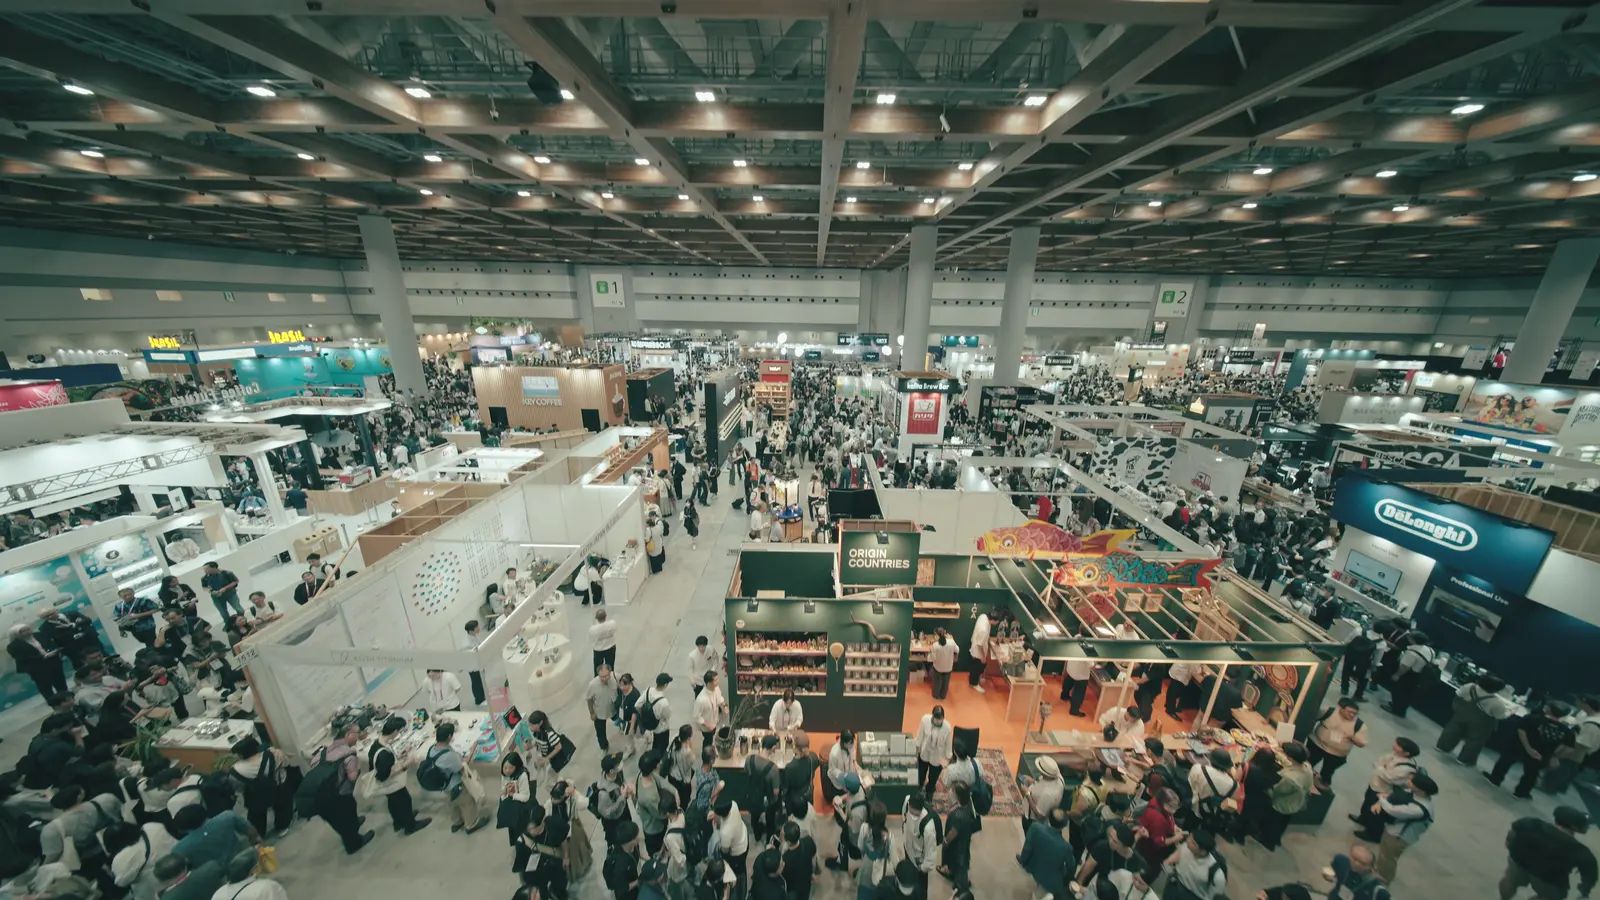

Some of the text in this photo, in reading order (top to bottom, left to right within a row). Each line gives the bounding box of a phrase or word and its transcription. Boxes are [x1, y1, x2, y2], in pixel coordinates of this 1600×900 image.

[611, 281, 618, 294] 1
[1177, 290, 1187, 304] 2
[849, 548, 887, 559] ORIGIN
[848, 559, 910, 569] COUNTRIES
[1450, 576, 1509, 606] Professional Use
[236, 650, 256, 664] 1512
